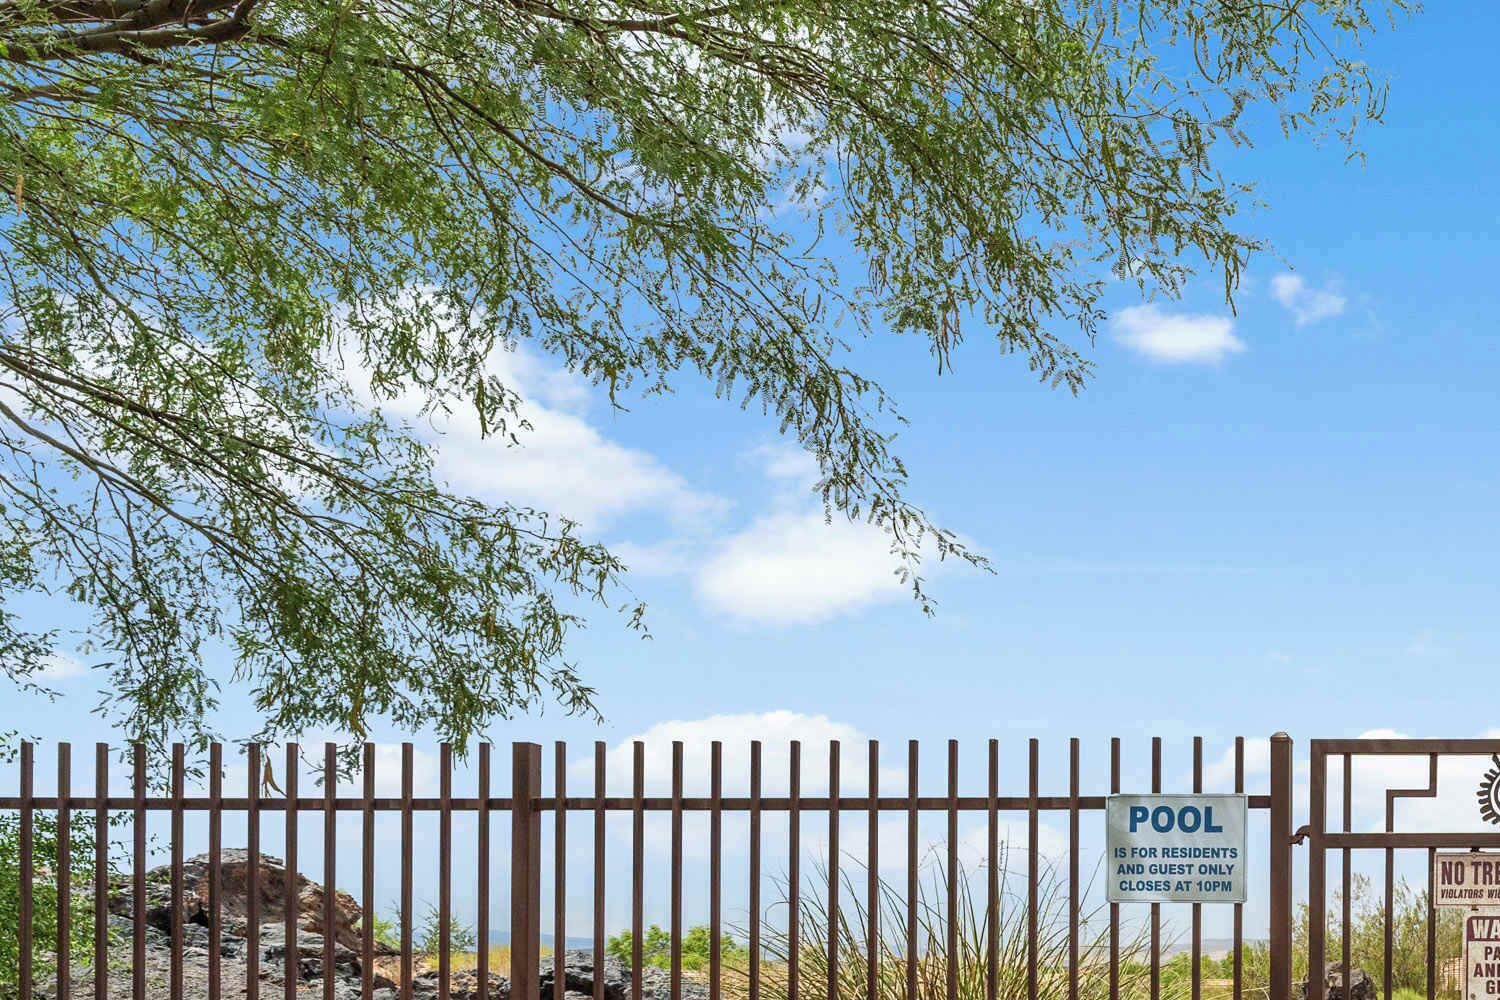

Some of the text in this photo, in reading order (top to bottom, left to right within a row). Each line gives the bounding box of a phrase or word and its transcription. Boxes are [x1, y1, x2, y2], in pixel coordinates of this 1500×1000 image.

[1129, 805, 1223, 833] POOL
[1114, 847, 1238, 859] IS FOR RESIDENTS
[1117, 863, 1235, 875] AND GUEST ONLY
[1441, 861, 1465, 885] NO
[1119, 880, 1232, 892] CLOSES AT 10PM
[1440, 889, 1484, 899] VIOLATORS
